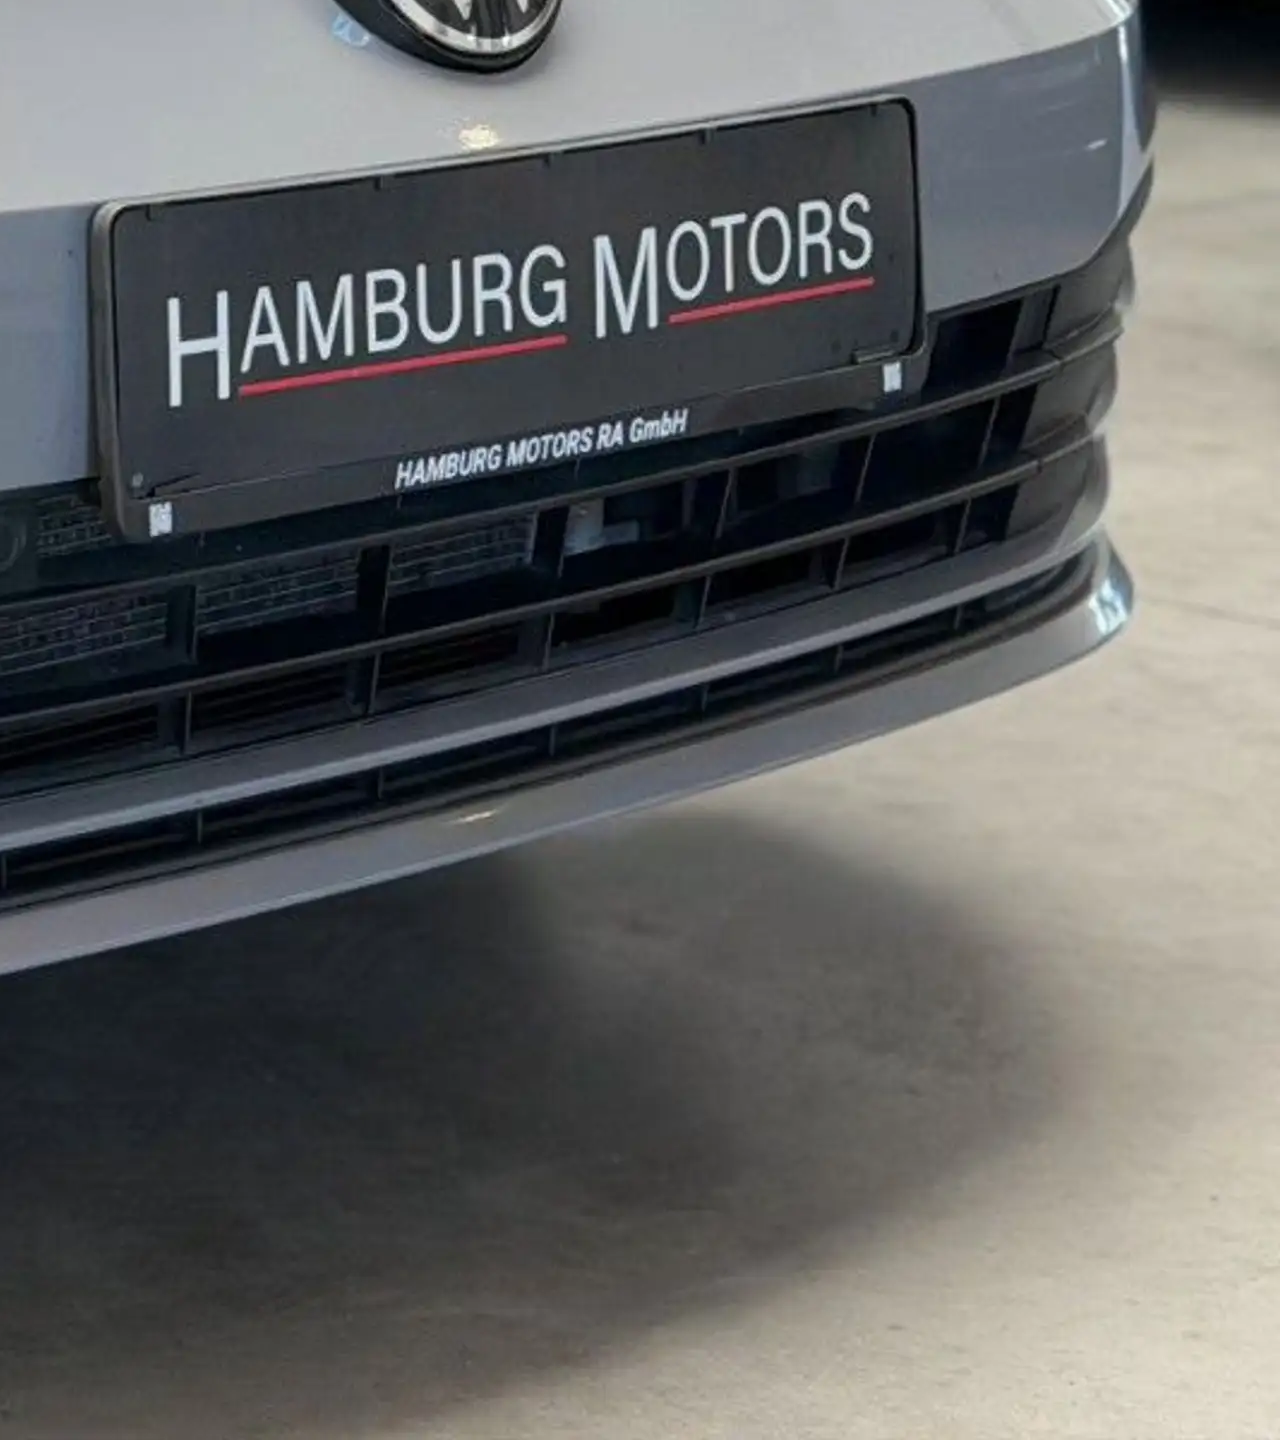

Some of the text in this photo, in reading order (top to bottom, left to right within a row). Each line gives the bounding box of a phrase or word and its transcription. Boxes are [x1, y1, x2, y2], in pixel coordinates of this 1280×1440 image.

[167, 191, 875, 407] HAMBURG MOTORS
[394, 408, 690, 490] HAMBURG MOTORS RA GmbH
